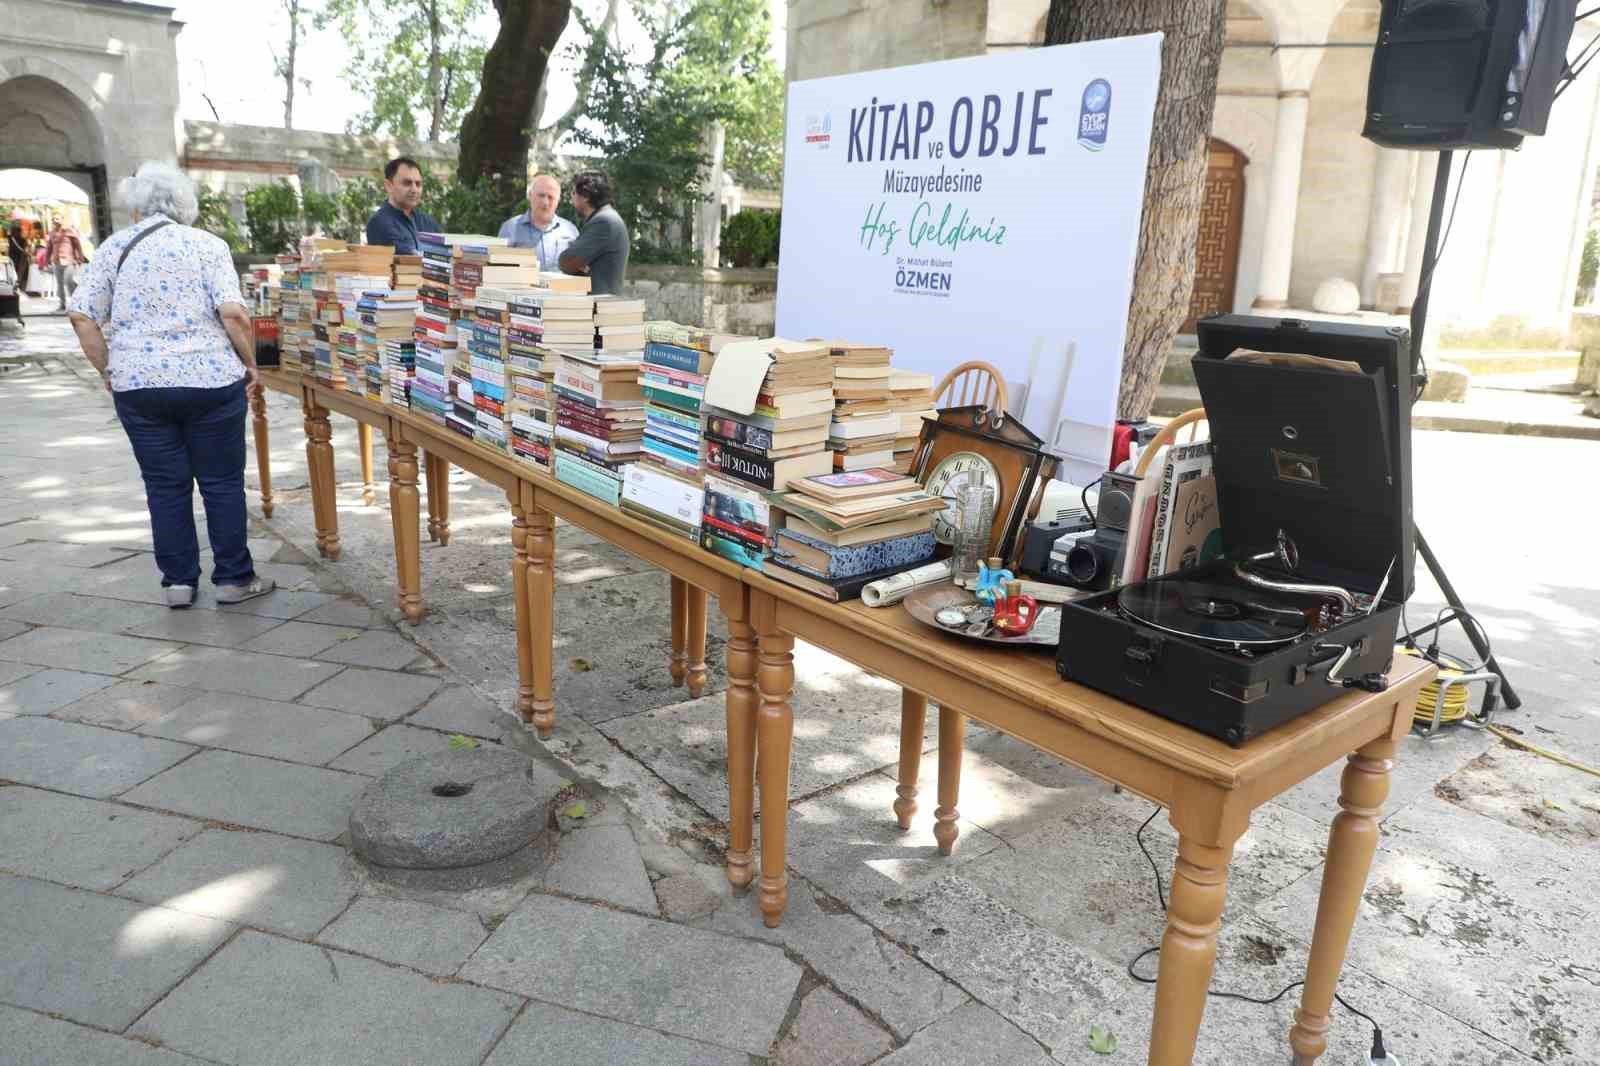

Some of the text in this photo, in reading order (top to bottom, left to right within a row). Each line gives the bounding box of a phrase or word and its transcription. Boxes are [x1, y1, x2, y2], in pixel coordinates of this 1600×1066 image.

[847, 88, 1053, 163] KİTAP ve OBJE
[883, 164, 983, 199] Müzayedesine
[860, 201, 1007, 255] Hoş Geldiniz
[895, 266, 952, 291] ÖZMEN
[732, 456, 767, 480] NUTUK
